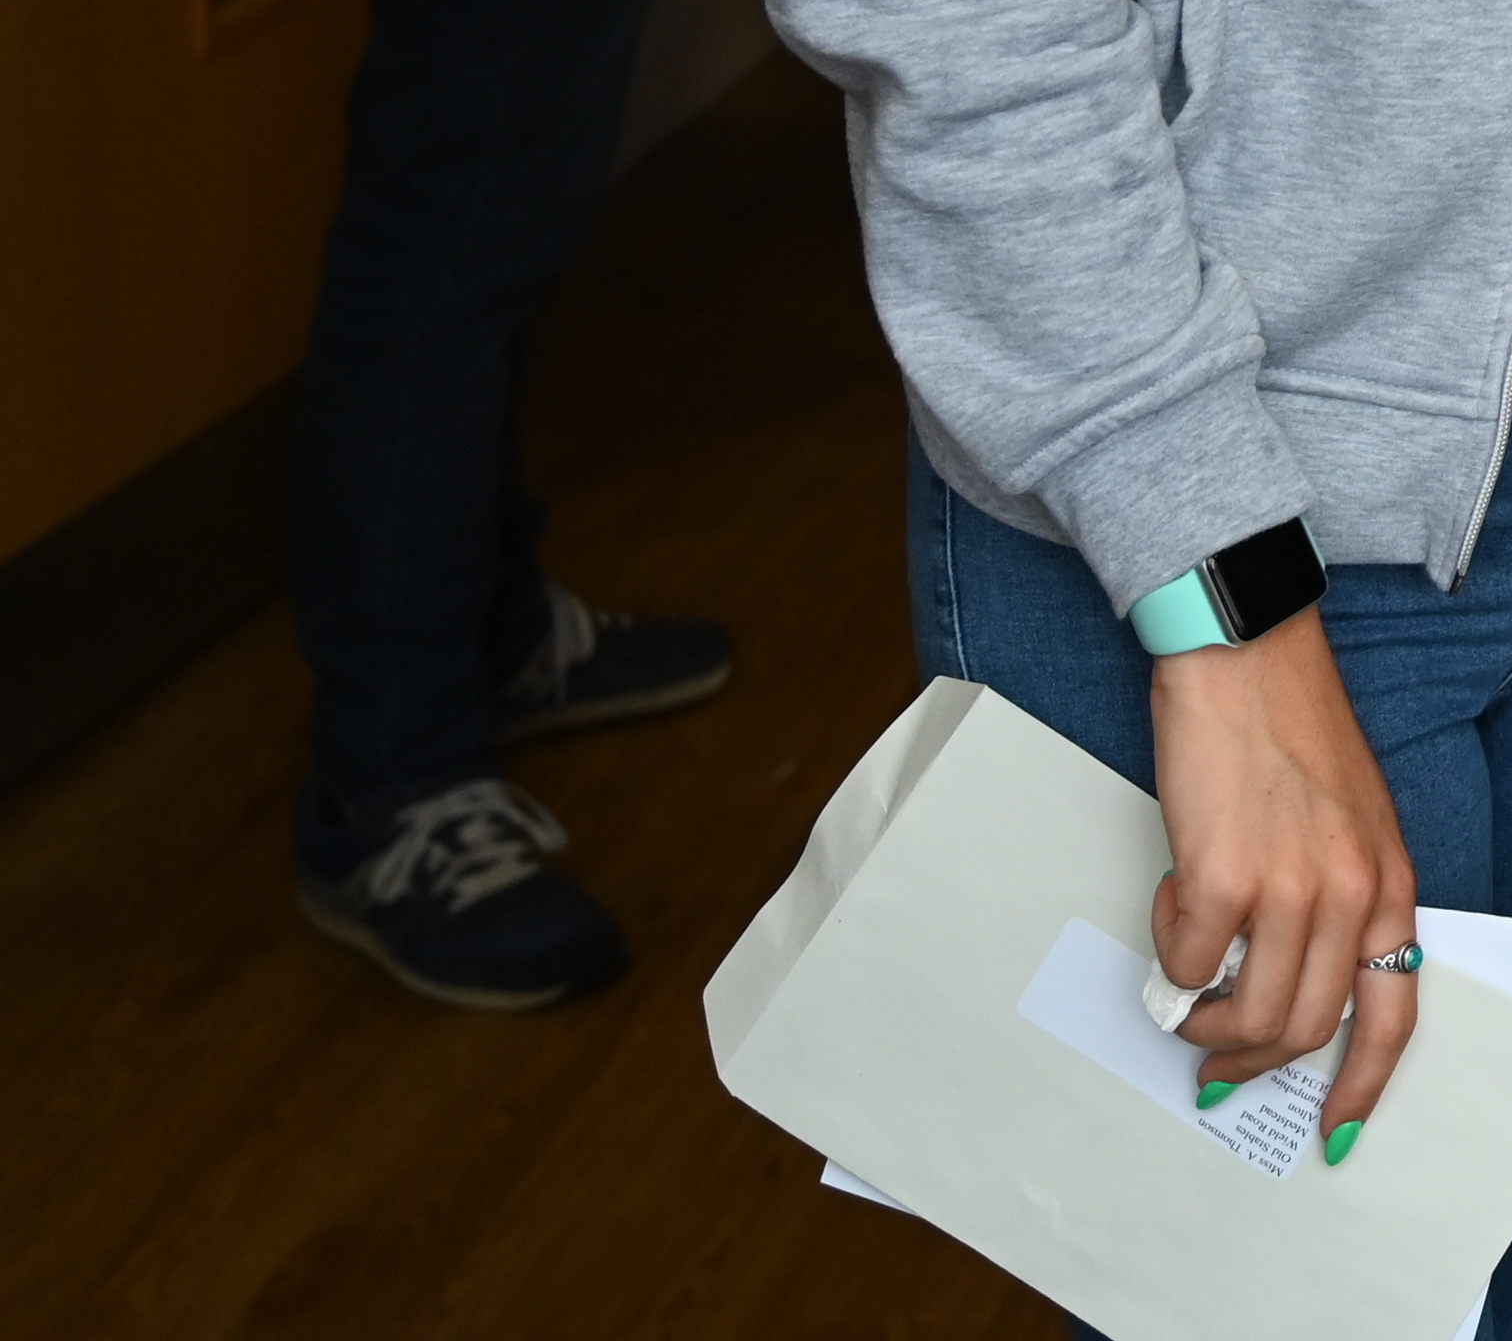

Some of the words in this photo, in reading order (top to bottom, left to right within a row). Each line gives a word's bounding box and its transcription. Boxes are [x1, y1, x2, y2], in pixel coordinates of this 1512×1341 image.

[1270, 1074, 1326, 1110] Hampshire
[1240, 1110, 1268, 1133] Road
[1258, 1104, 1309, 1138] Medstead
[1287, 1102, 1318, 1123] Alton
[1198, 1117, 1242, 1154] Thomson
[1235, 1124, 1271, 1153] Stables
[1268, 1129, 1298, 1152] Wield
[1258, 1157, 1284, 1177] Miss
[1271, 1147, 1292, 1164] Old
